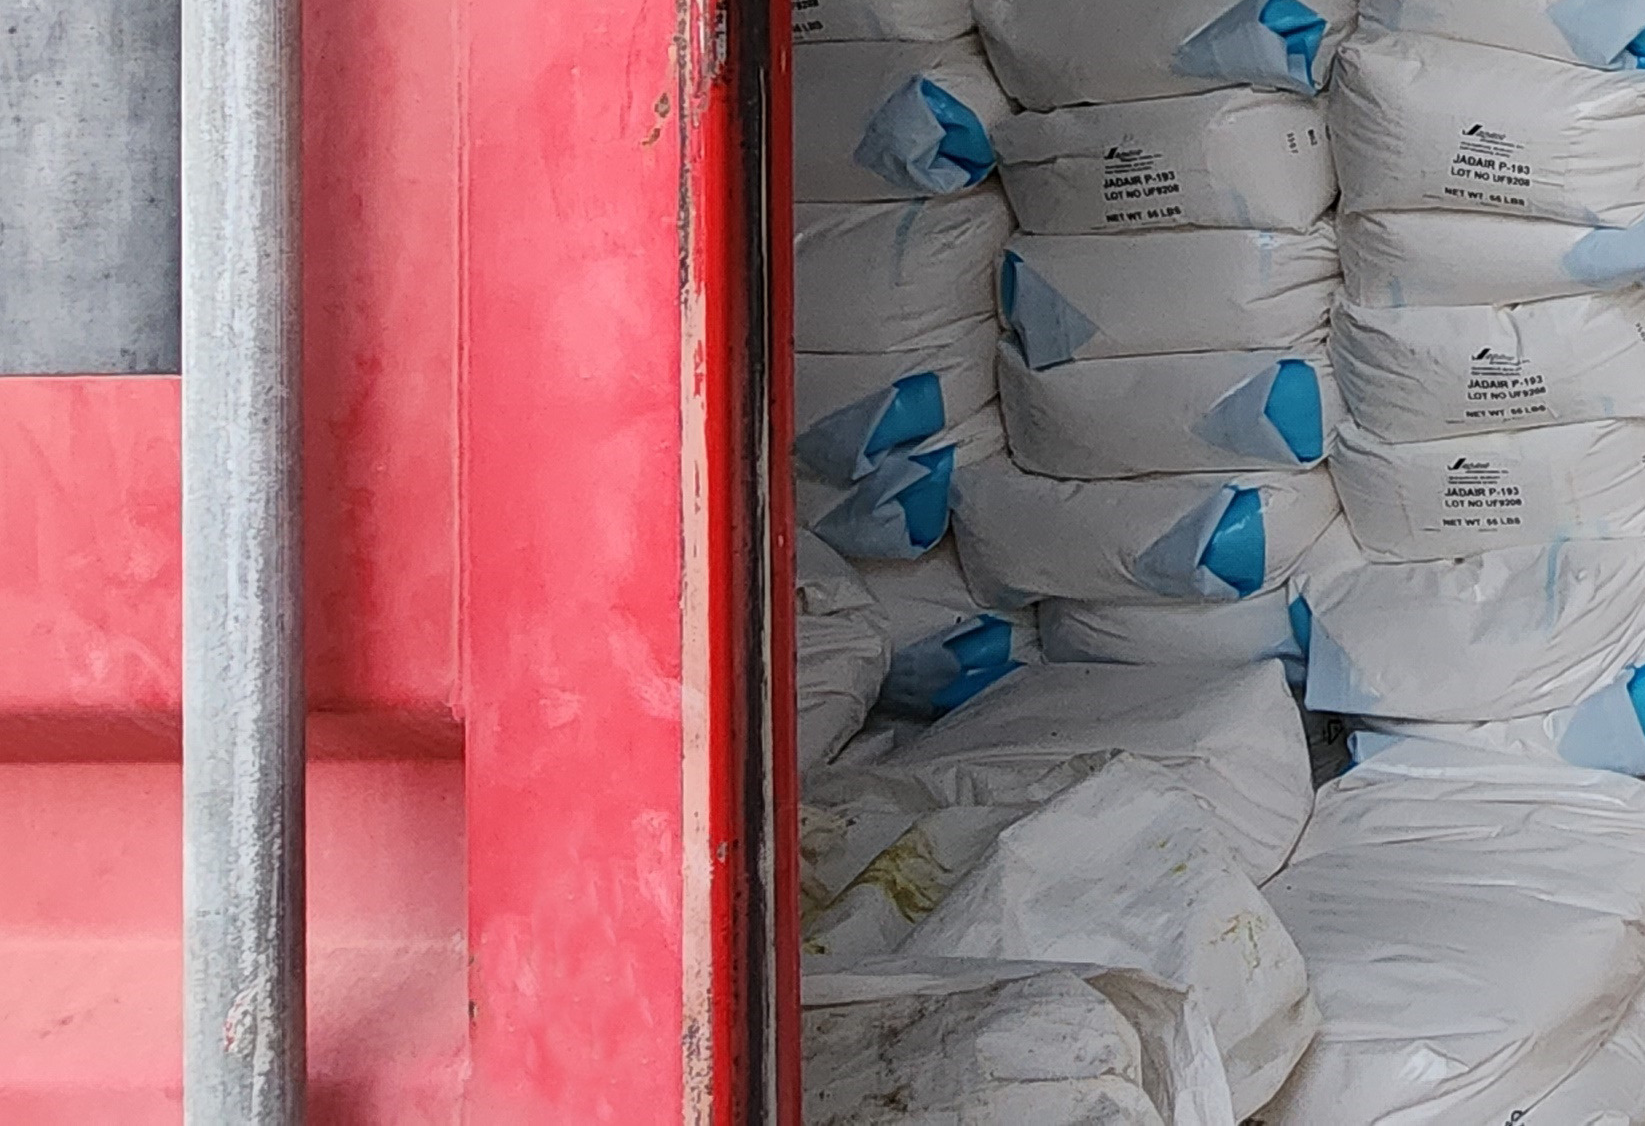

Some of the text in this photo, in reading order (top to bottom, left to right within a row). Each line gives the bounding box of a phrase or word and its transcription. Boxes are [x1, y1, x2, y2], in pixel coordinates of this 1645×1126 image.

[1453, 154, 1530, 175] JADAIR P-193
[1451, 166, 1471, 178] LOT
[1474, 171, 1490, 181] NO
[1468, 375, 1543, 389] JADAIR P-193
[1445, 487, 1519, 497] JADAIR P-193
[1445, 500, 1464, 508] LOT
